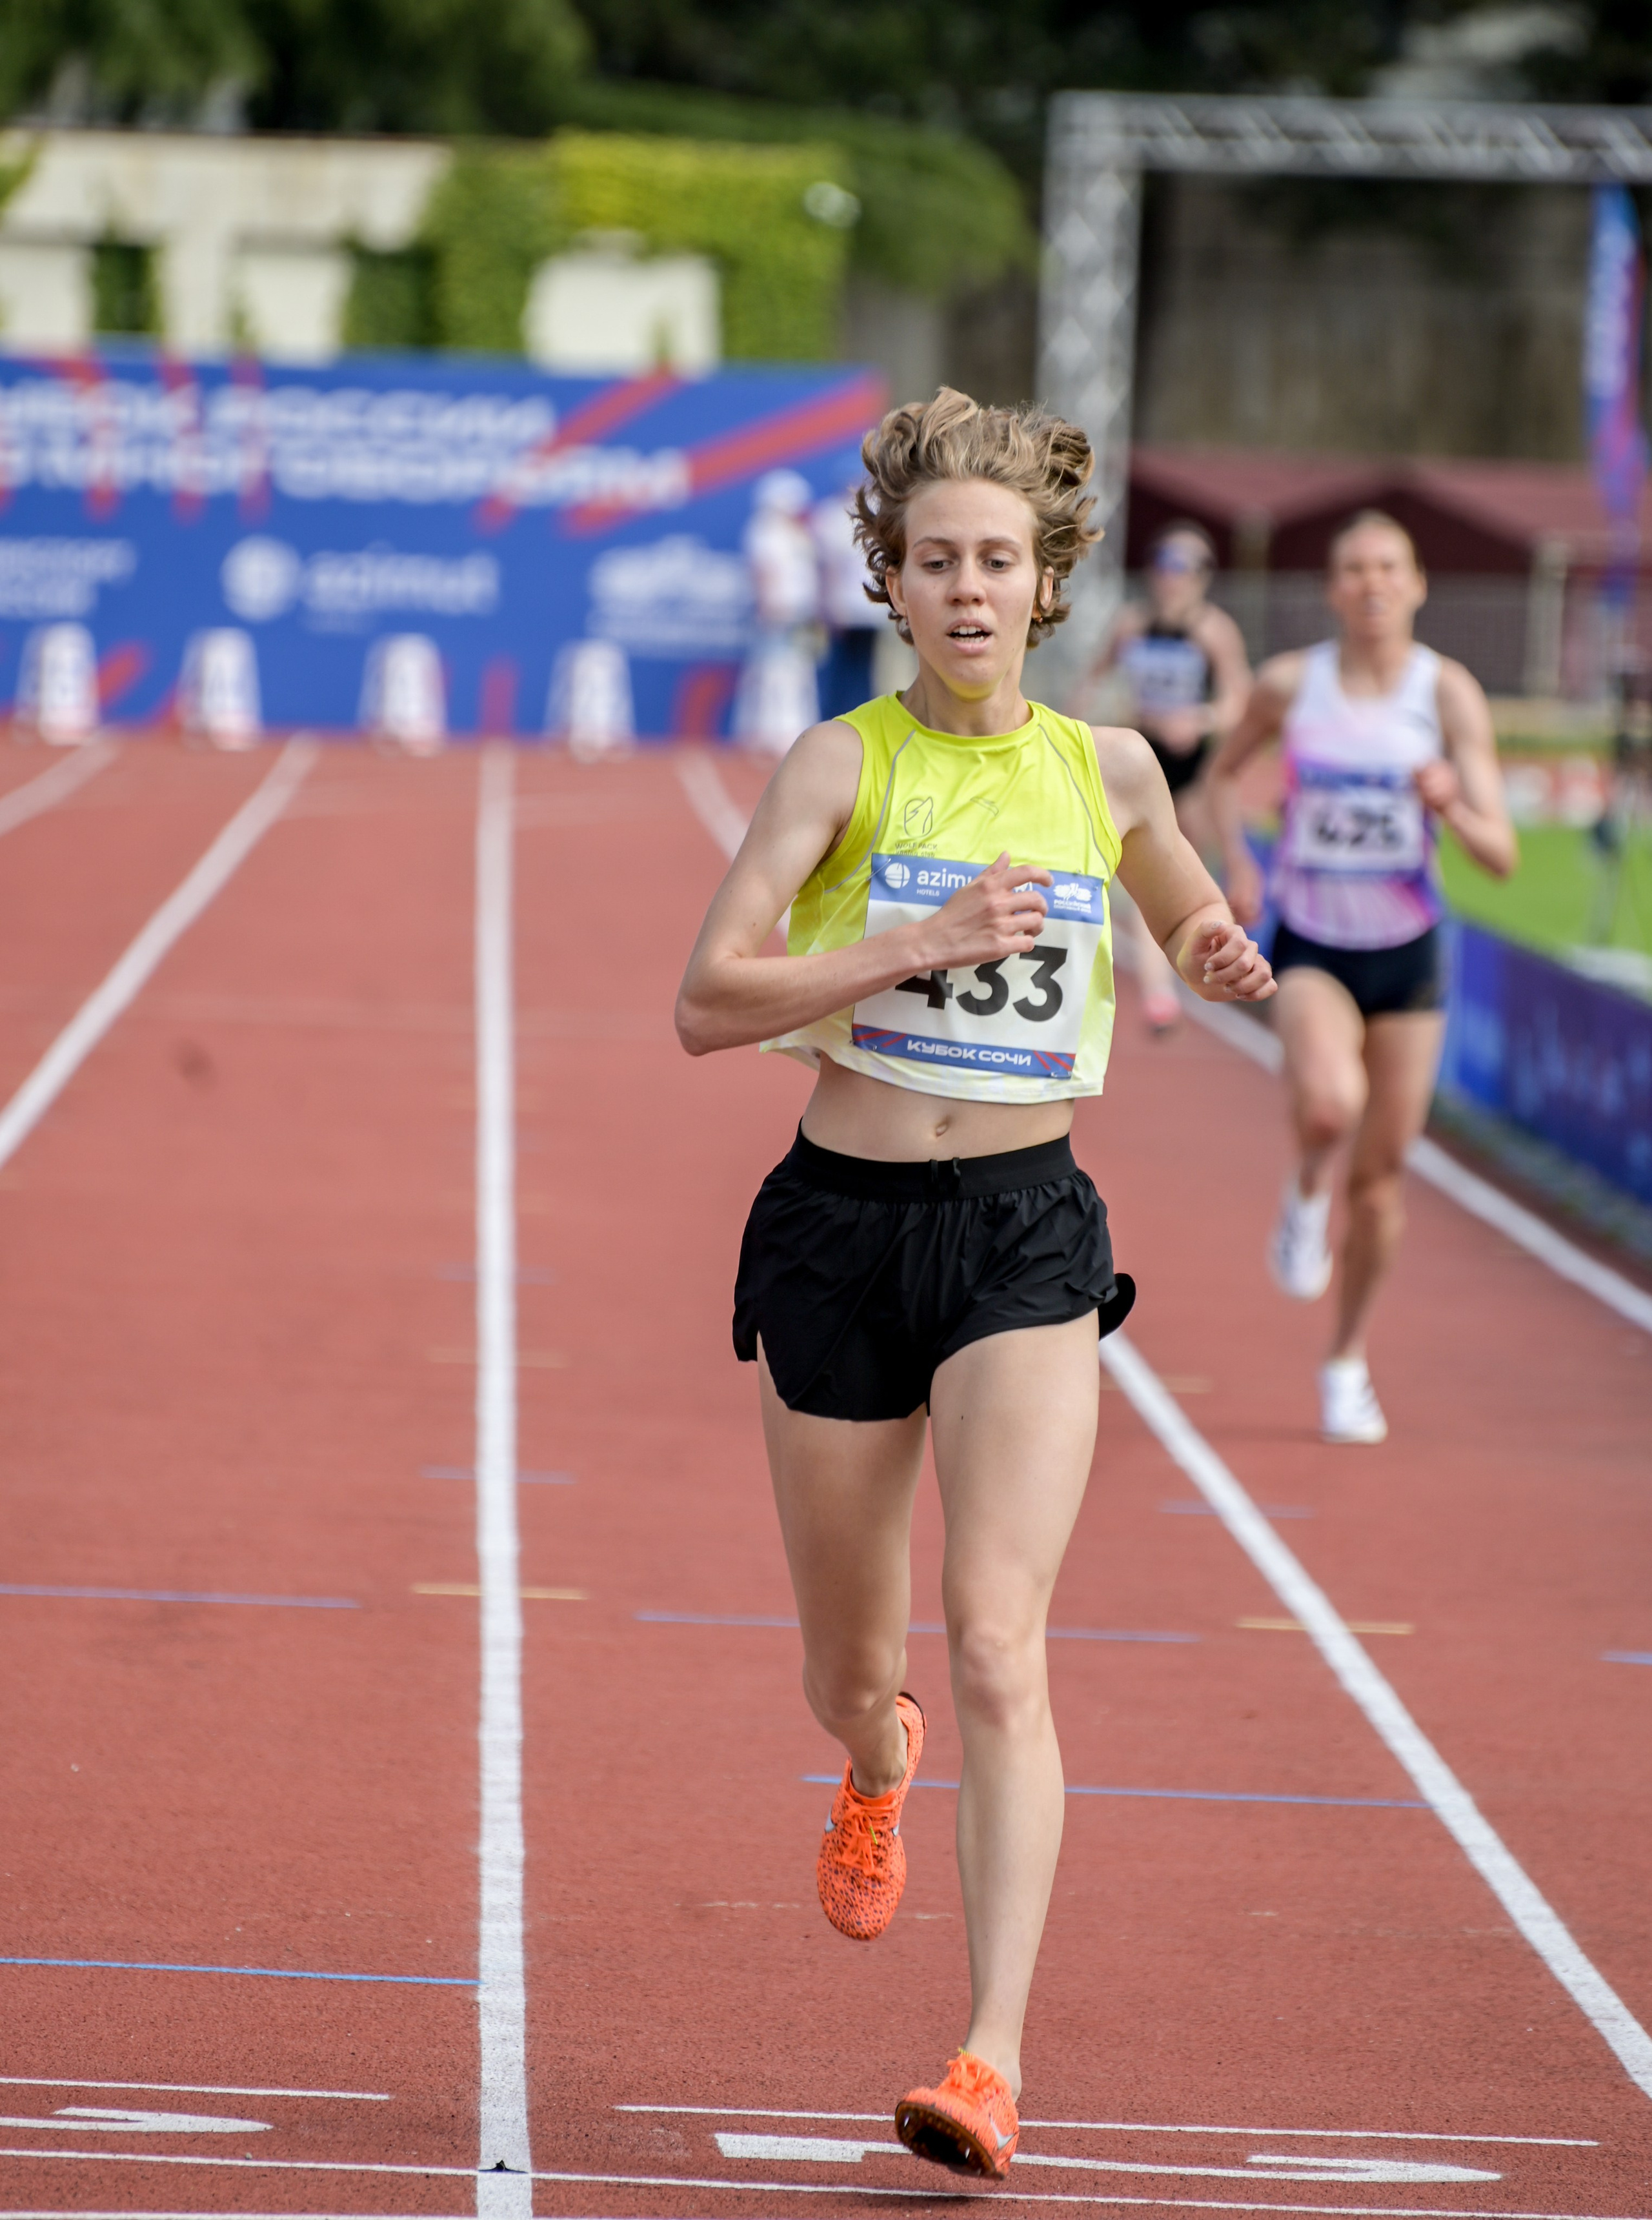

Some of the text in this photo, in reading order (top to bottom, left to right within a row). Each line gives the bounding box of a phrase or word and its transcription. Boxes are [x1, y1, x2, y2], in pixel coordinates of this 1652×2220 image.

[918, 842, 938, 851] PACK
[917, 867, 972, 889] azim
[916, 889, 940, 897] HOTELS
[894, 945, 1068, 1022] 433
[907, 1040, 1032, 1066] КУБОК СОЧИ
